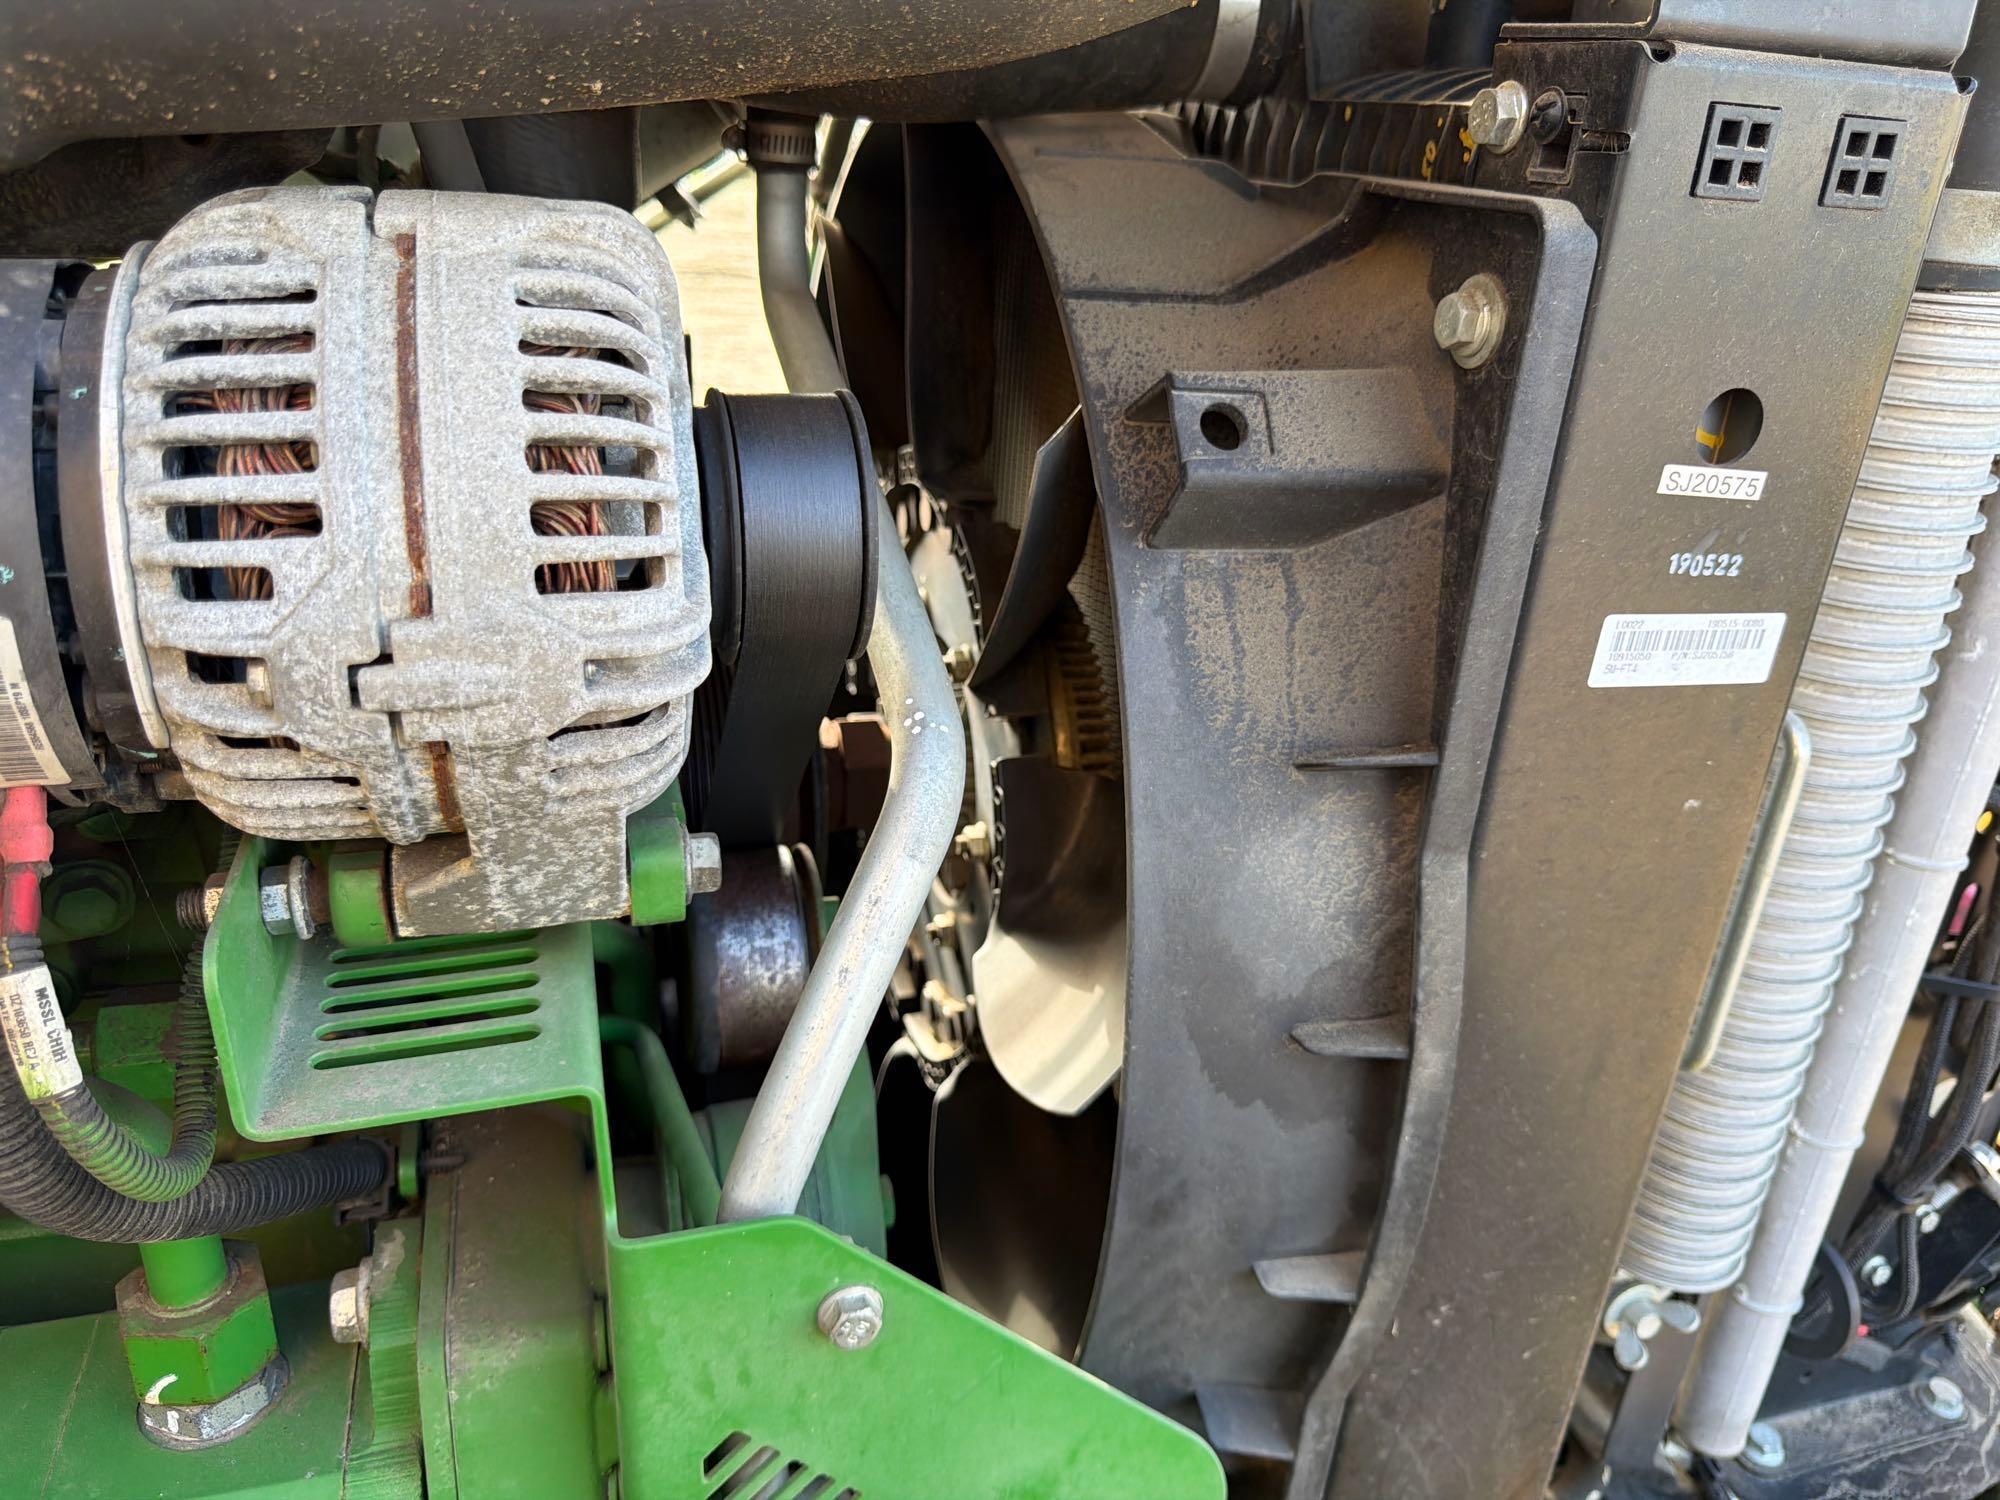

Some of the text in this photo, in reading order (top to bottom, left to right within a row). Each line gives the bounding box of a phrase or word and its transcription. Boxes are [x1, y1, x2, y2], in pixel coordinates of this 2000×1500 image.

[1666, 471, 1760, 497] SJ20575
[1669, 552, 1744, 577] 190522
[34, 986, 56, 1027] MSSL
